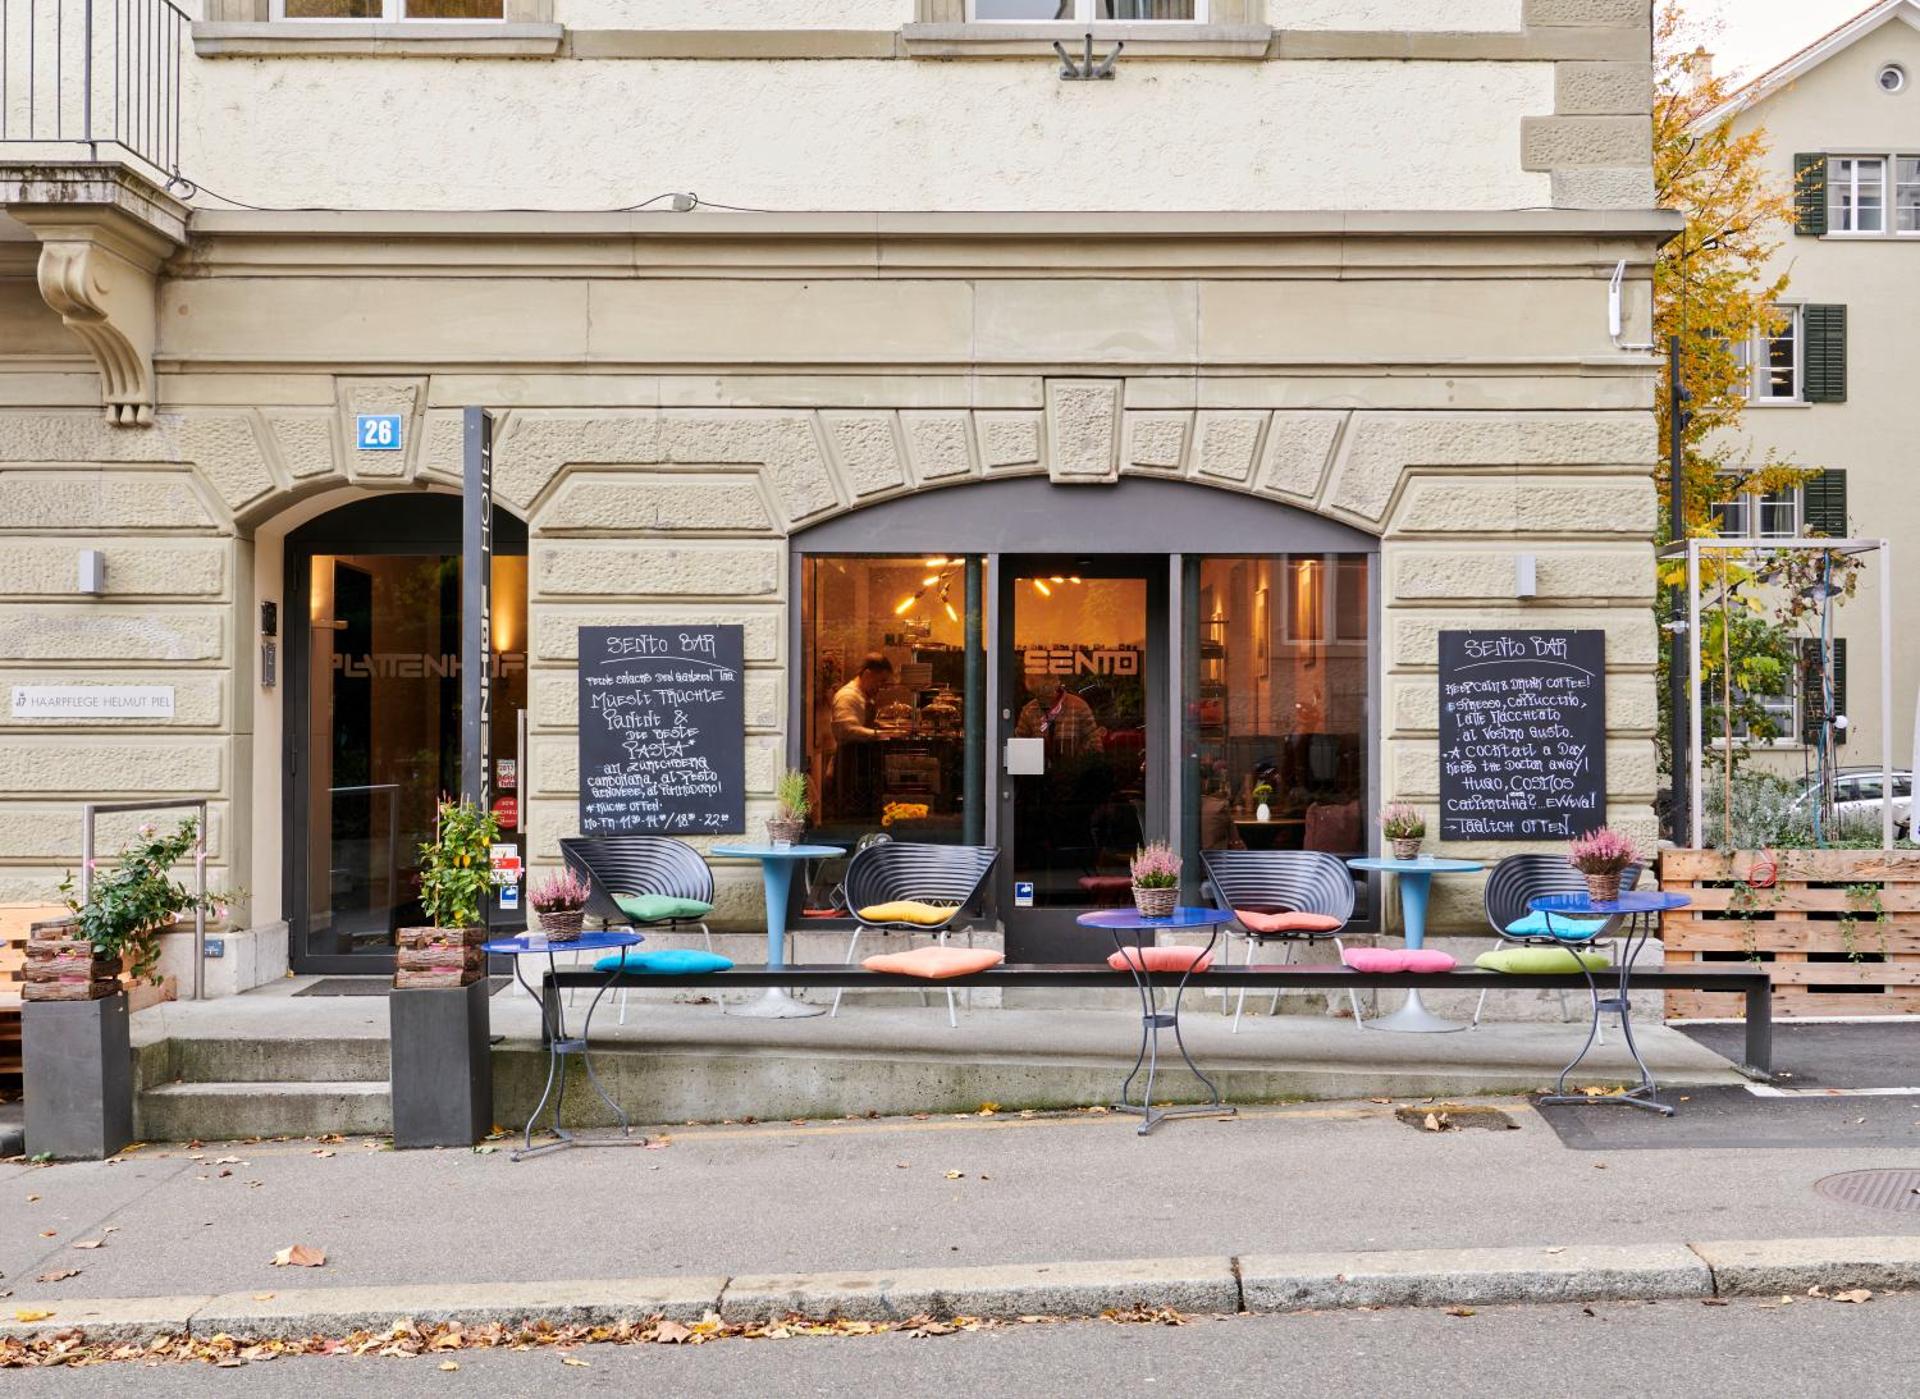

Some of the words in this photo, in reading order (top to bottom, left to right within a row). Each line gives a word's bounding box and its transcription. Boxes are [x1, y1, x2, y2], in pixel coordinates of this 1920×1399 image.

[365, 420, 392, 444] 26
[481, 443, 490, 551] HOTEL
[679, 633, 717, 658] BAR
[1528, 636, 1568, 660] BAR
[1024, 651, 1138, 675] SENTO
[31, 696, 98, 708] HAARPFLEGE
[103, 696, 147, 708] HELMUT
[151, 696, 171, 708] PIEL
[674, 709, 689, 725] &
